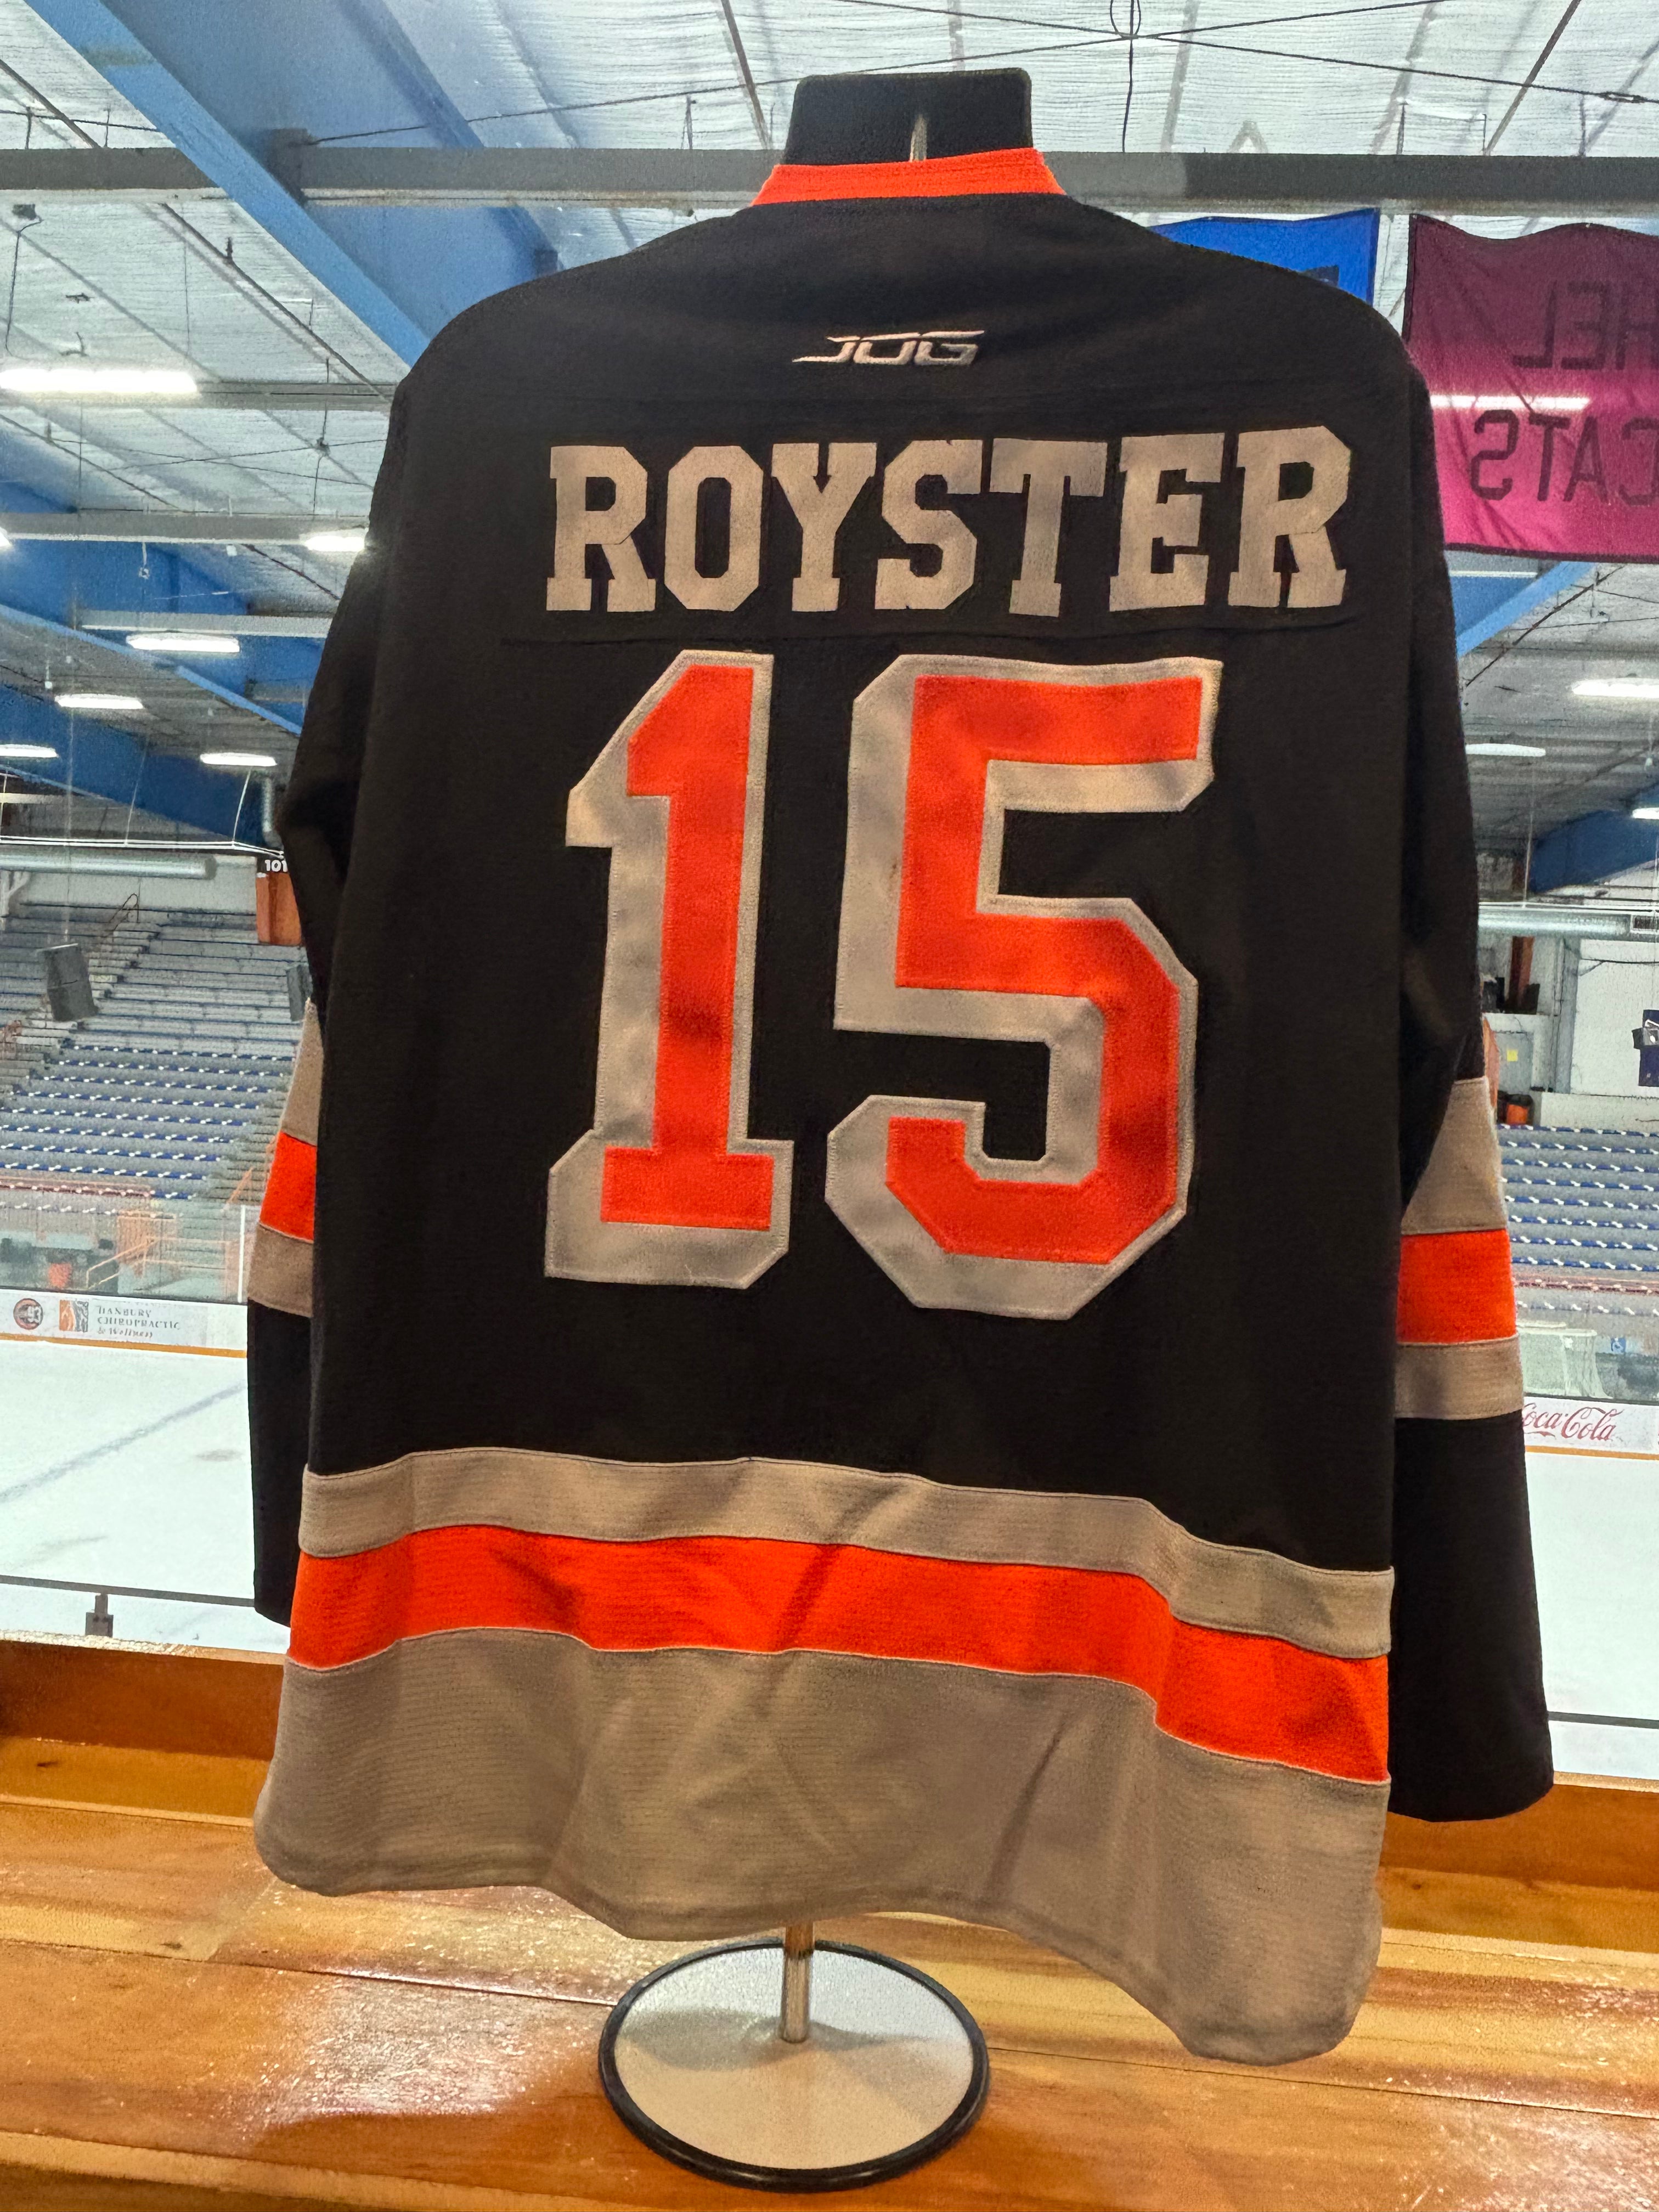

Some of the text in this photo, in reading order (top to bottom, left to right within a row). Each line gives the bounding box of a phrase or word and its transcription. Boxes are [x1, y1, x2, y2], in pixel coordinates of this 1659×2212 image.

[792, 330, 985, 366] JOG
[546, 425, 1351, 618] ROYSTER
[264, 859, 289, 872] 101
[544, 649, 1224, 1320] 15
